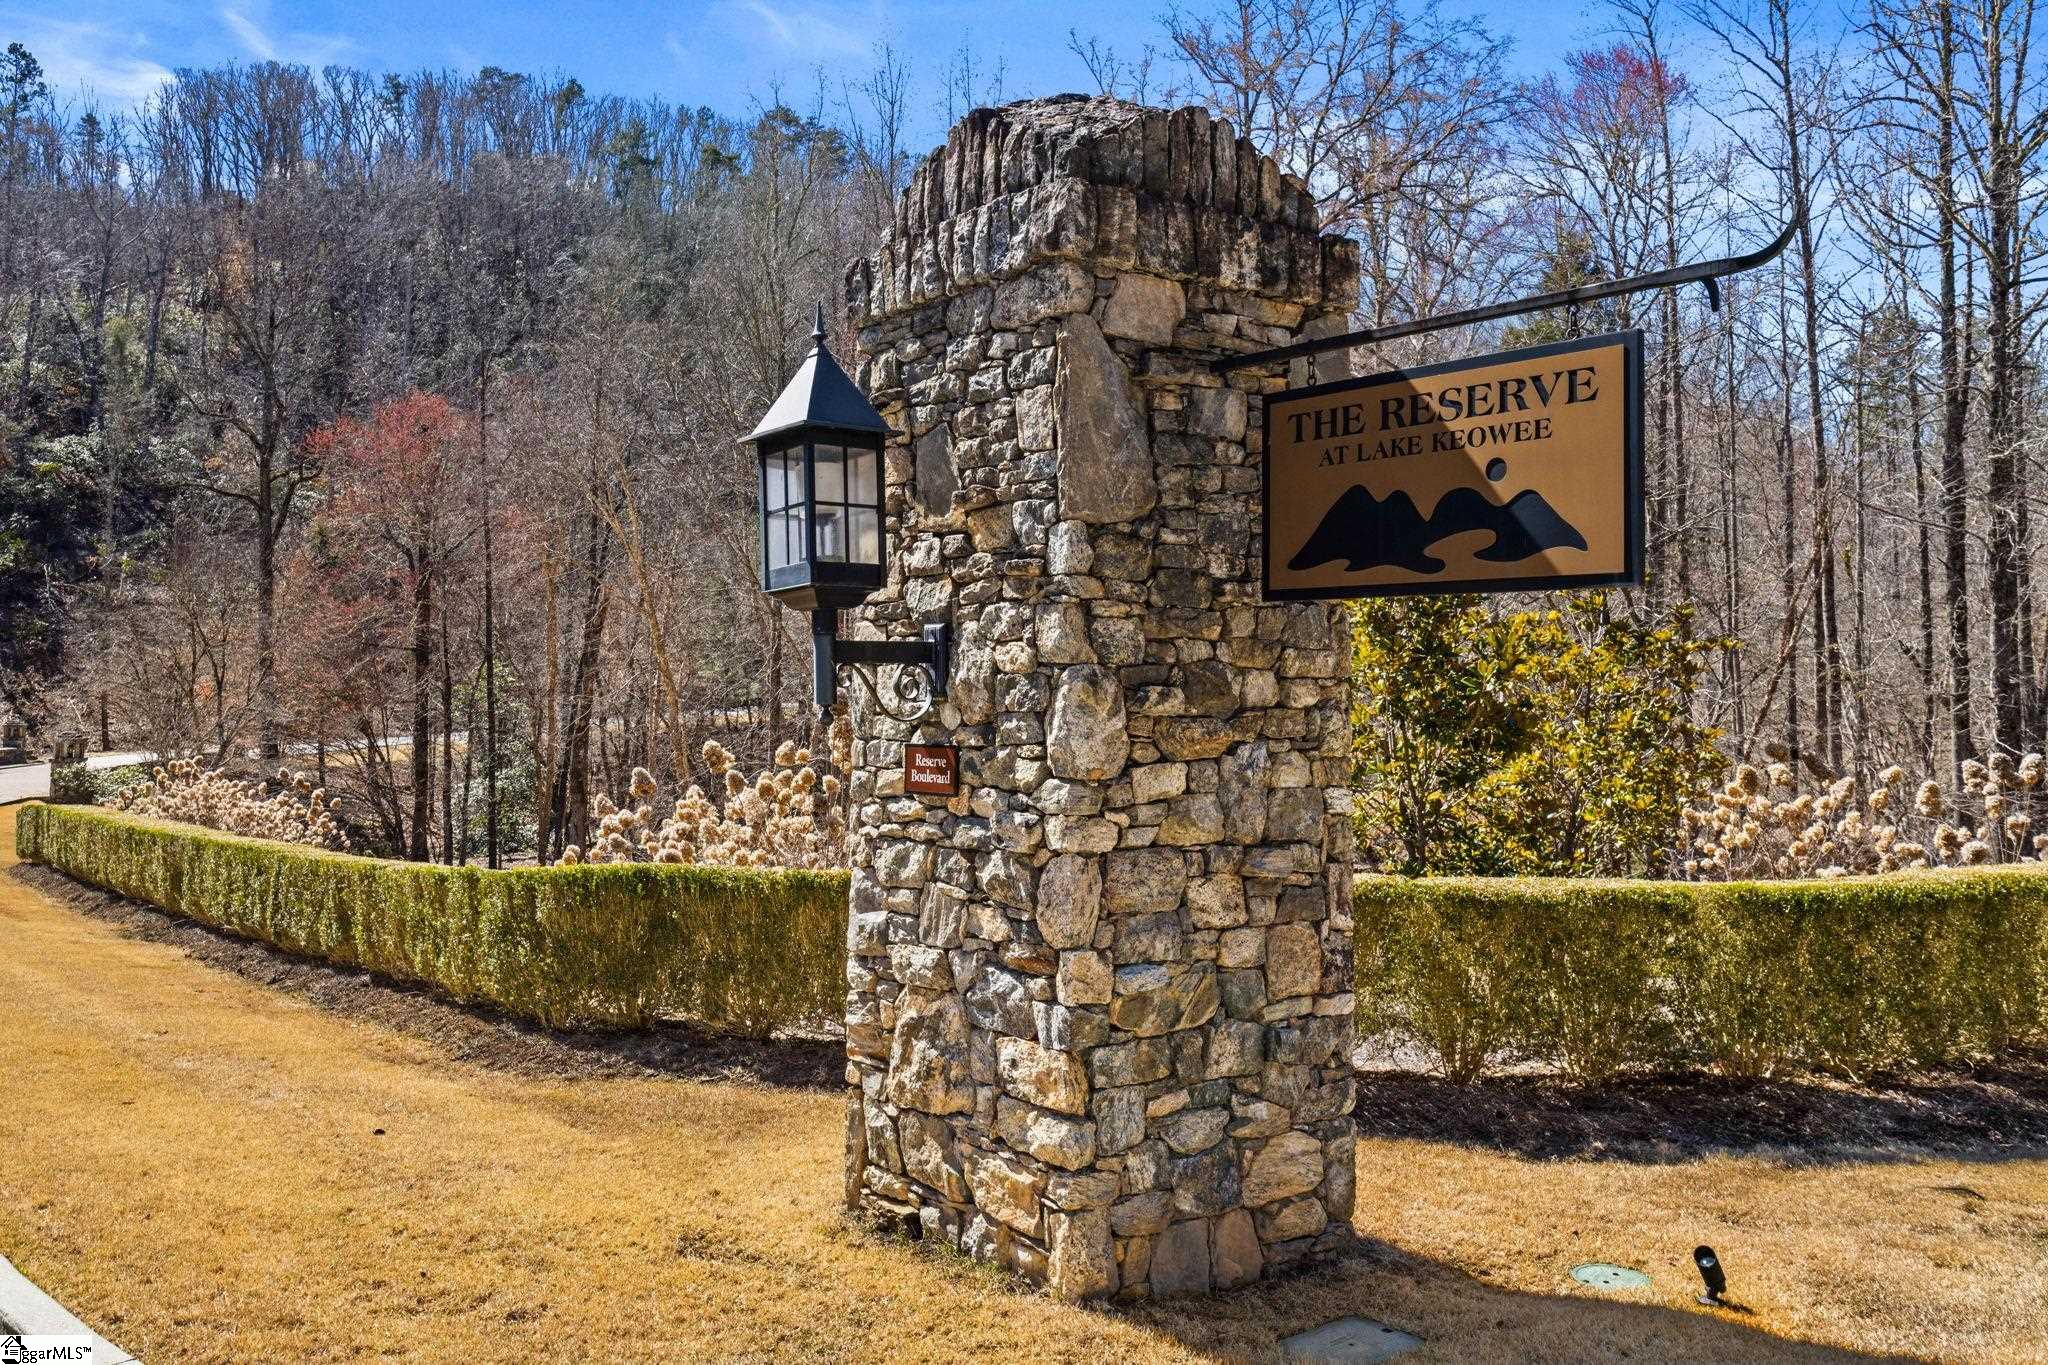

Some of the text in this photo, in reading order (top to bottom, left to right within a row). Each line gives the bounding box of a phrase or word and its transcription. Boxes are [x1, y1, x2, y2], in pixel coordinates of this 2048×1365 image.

[1287, 366, 1600, 444] THE RESERVE
[1318, 417, 1553, 468] AT LAKE KEOWEE
[911, 769, 950, 784] Boulevard
[915, 753, 947, 768] Reserve
